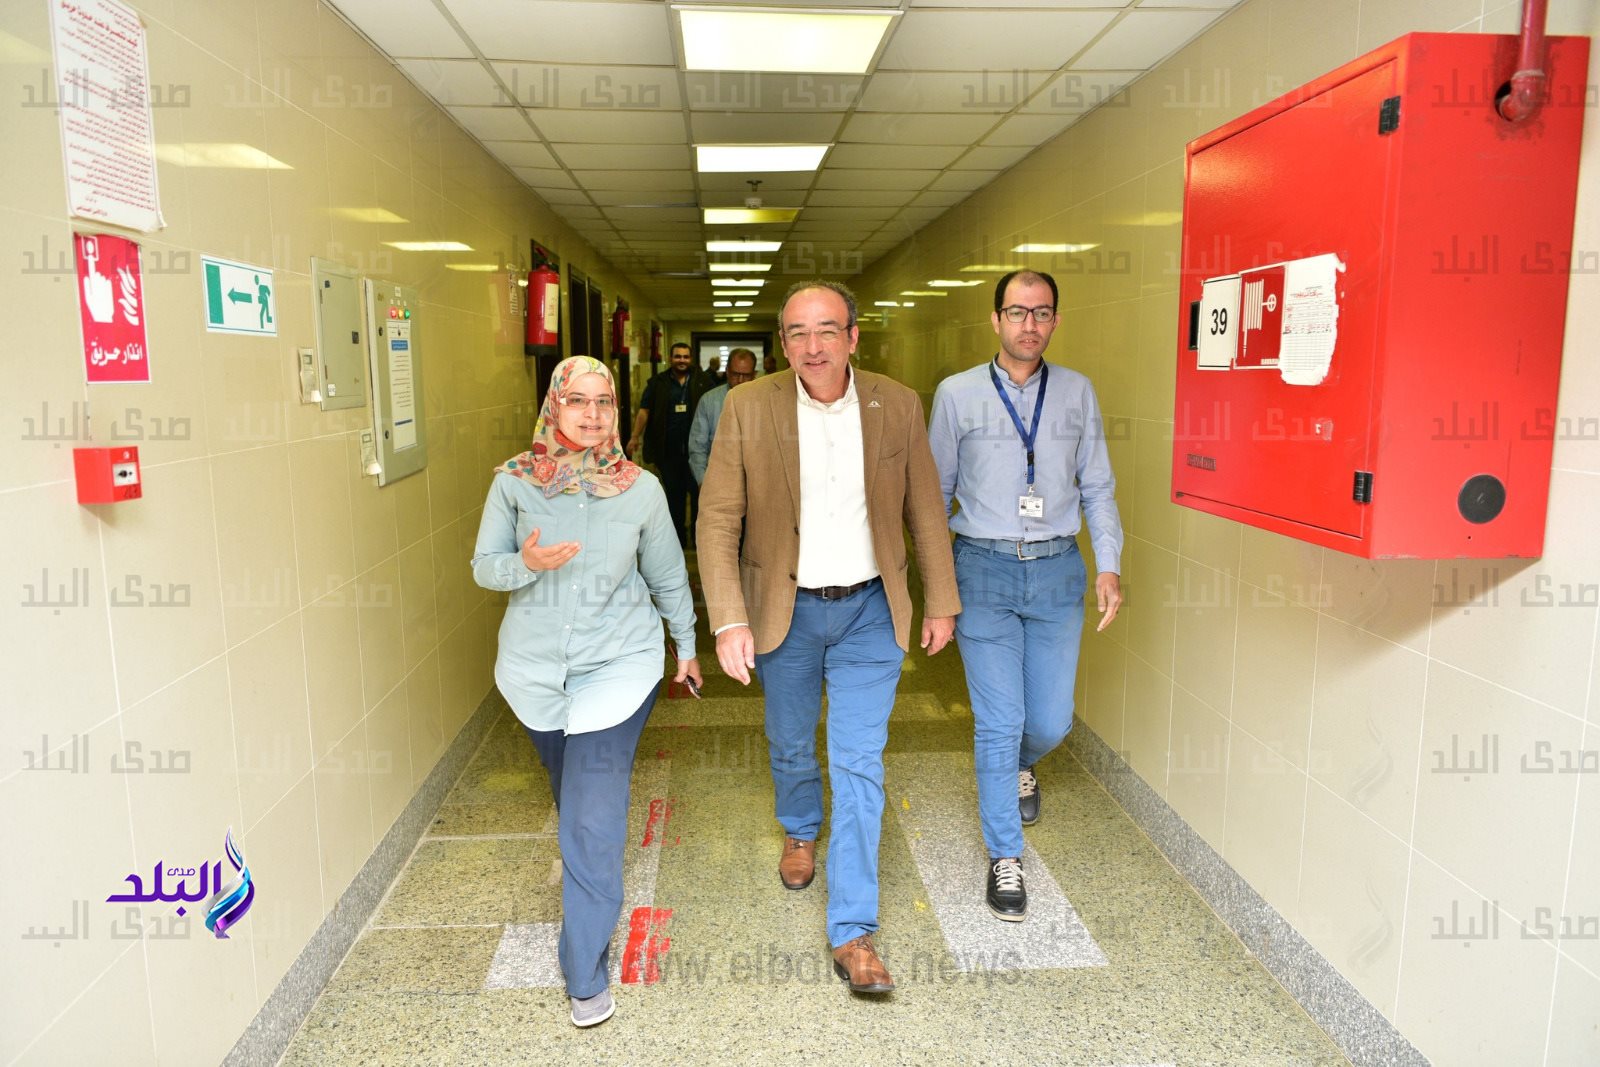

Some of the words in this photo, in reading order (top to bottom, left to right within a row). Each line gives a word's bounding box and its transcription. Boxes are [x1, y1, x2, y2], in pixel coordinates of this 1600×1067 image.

[1210, 307, 1228, 336] 39
[90, 341, 120, 366] حريق
[122, 343, 143, 365] انذار
